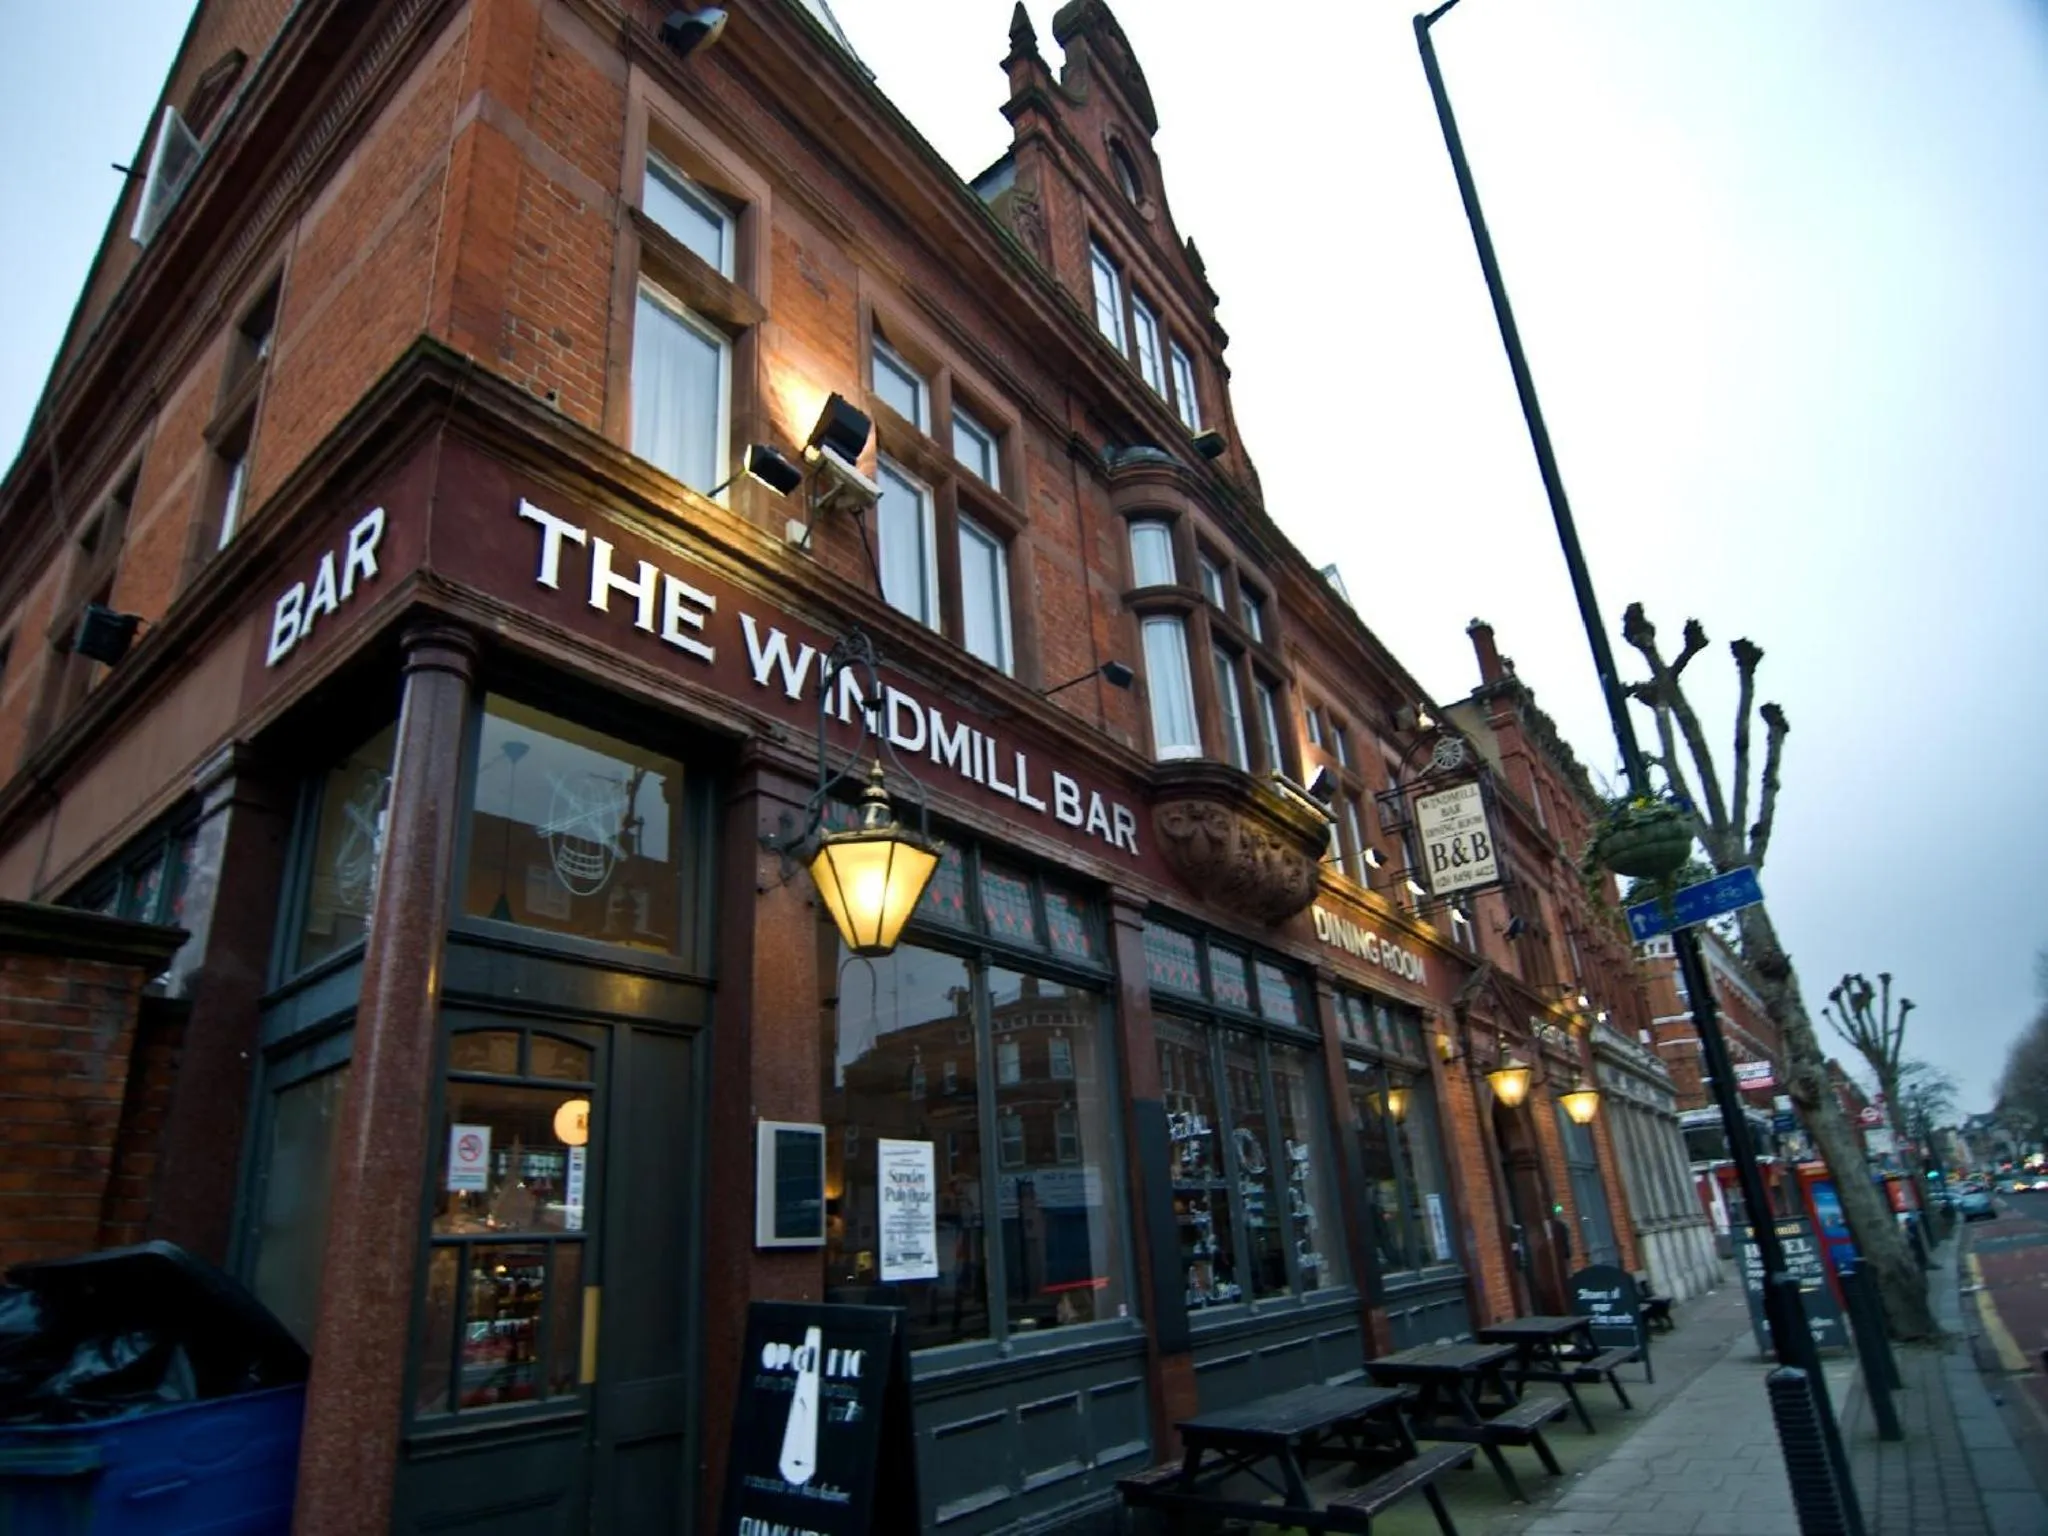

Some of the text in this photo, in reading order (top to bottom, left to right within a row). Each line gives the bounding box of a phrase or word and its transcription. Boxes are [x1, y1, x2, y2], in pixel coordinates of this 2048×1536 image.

[265, 507, 387, 667] BAR
[519, 497, 1140, 856] THE WINDMILL BAR
[1430, 831, 1490, 873] B&B
[1311, 904, 1428, 987] DINING ROOM
